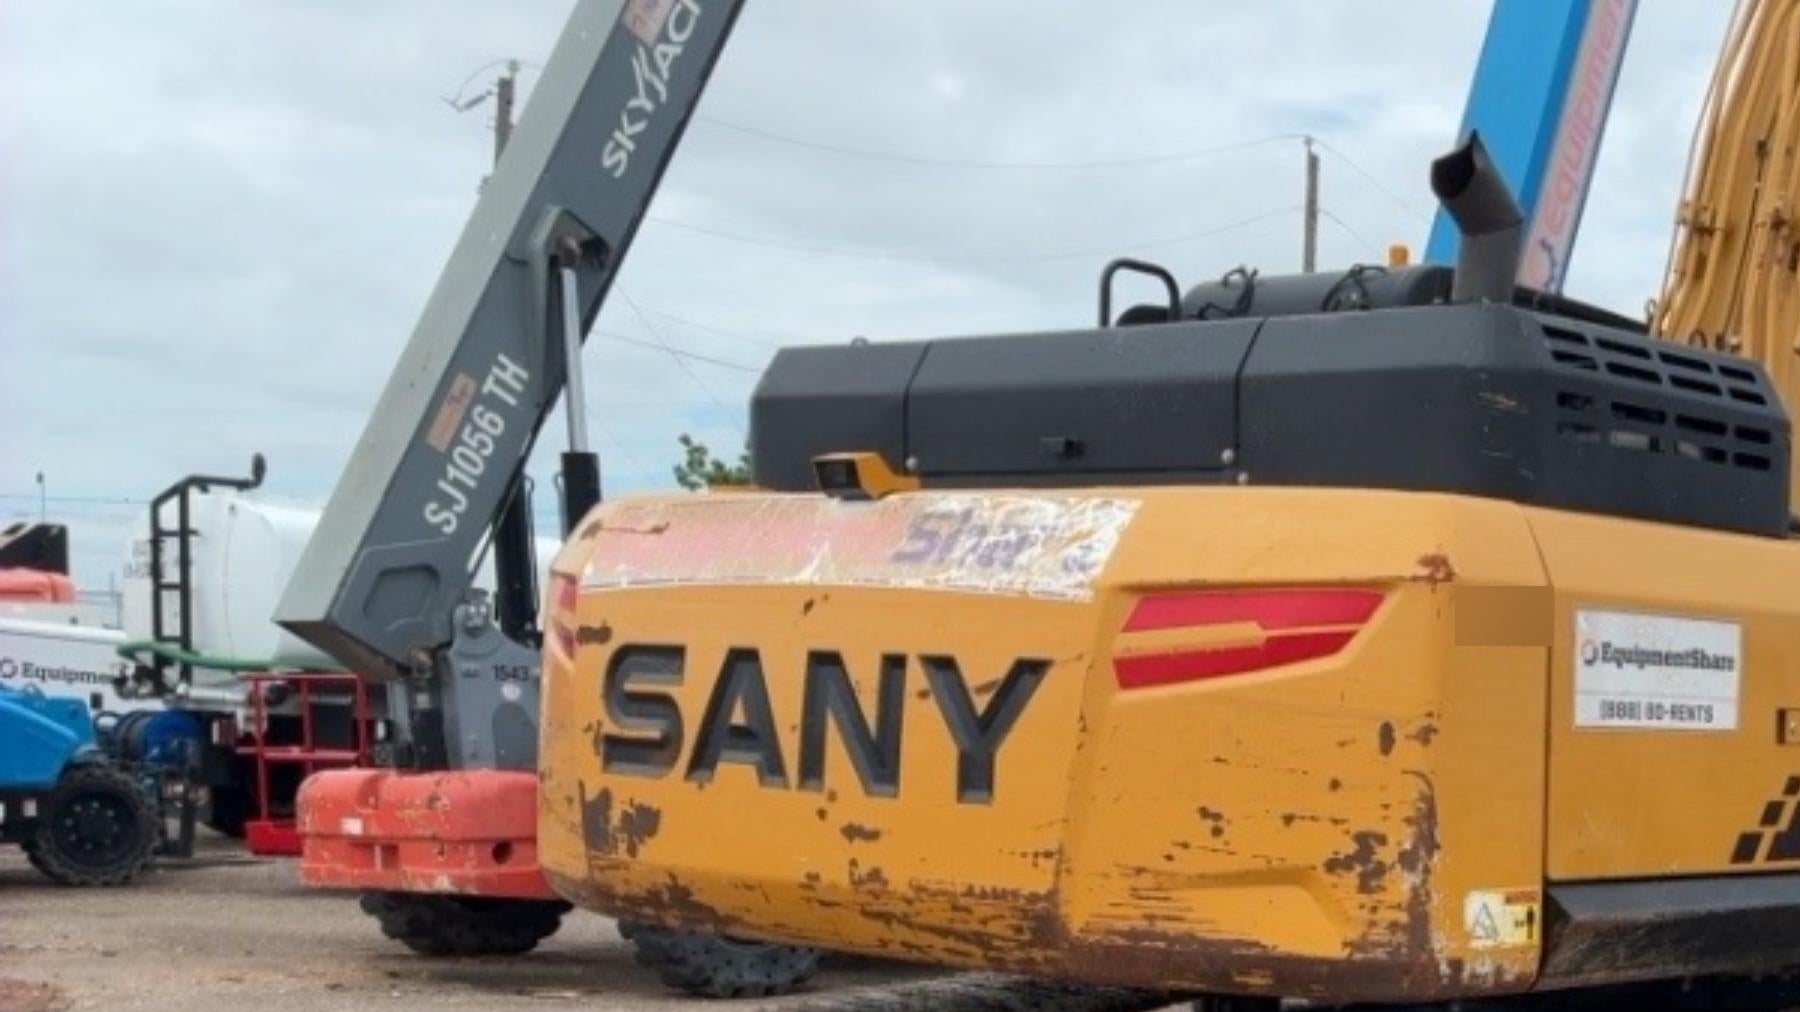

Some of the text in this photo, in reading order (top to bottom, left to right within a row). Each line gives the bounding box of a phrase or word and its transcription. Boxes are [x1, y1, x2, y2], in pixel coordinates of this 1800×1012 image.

[602, 0, 702, 178] SKYJAC
[424, 404, 505, 534] SJ1056
[482, 353, 529, 406] TH
[601, 642, 1054, 805] SANY
[1601, 641, 1735, 672] EquipmentShare
